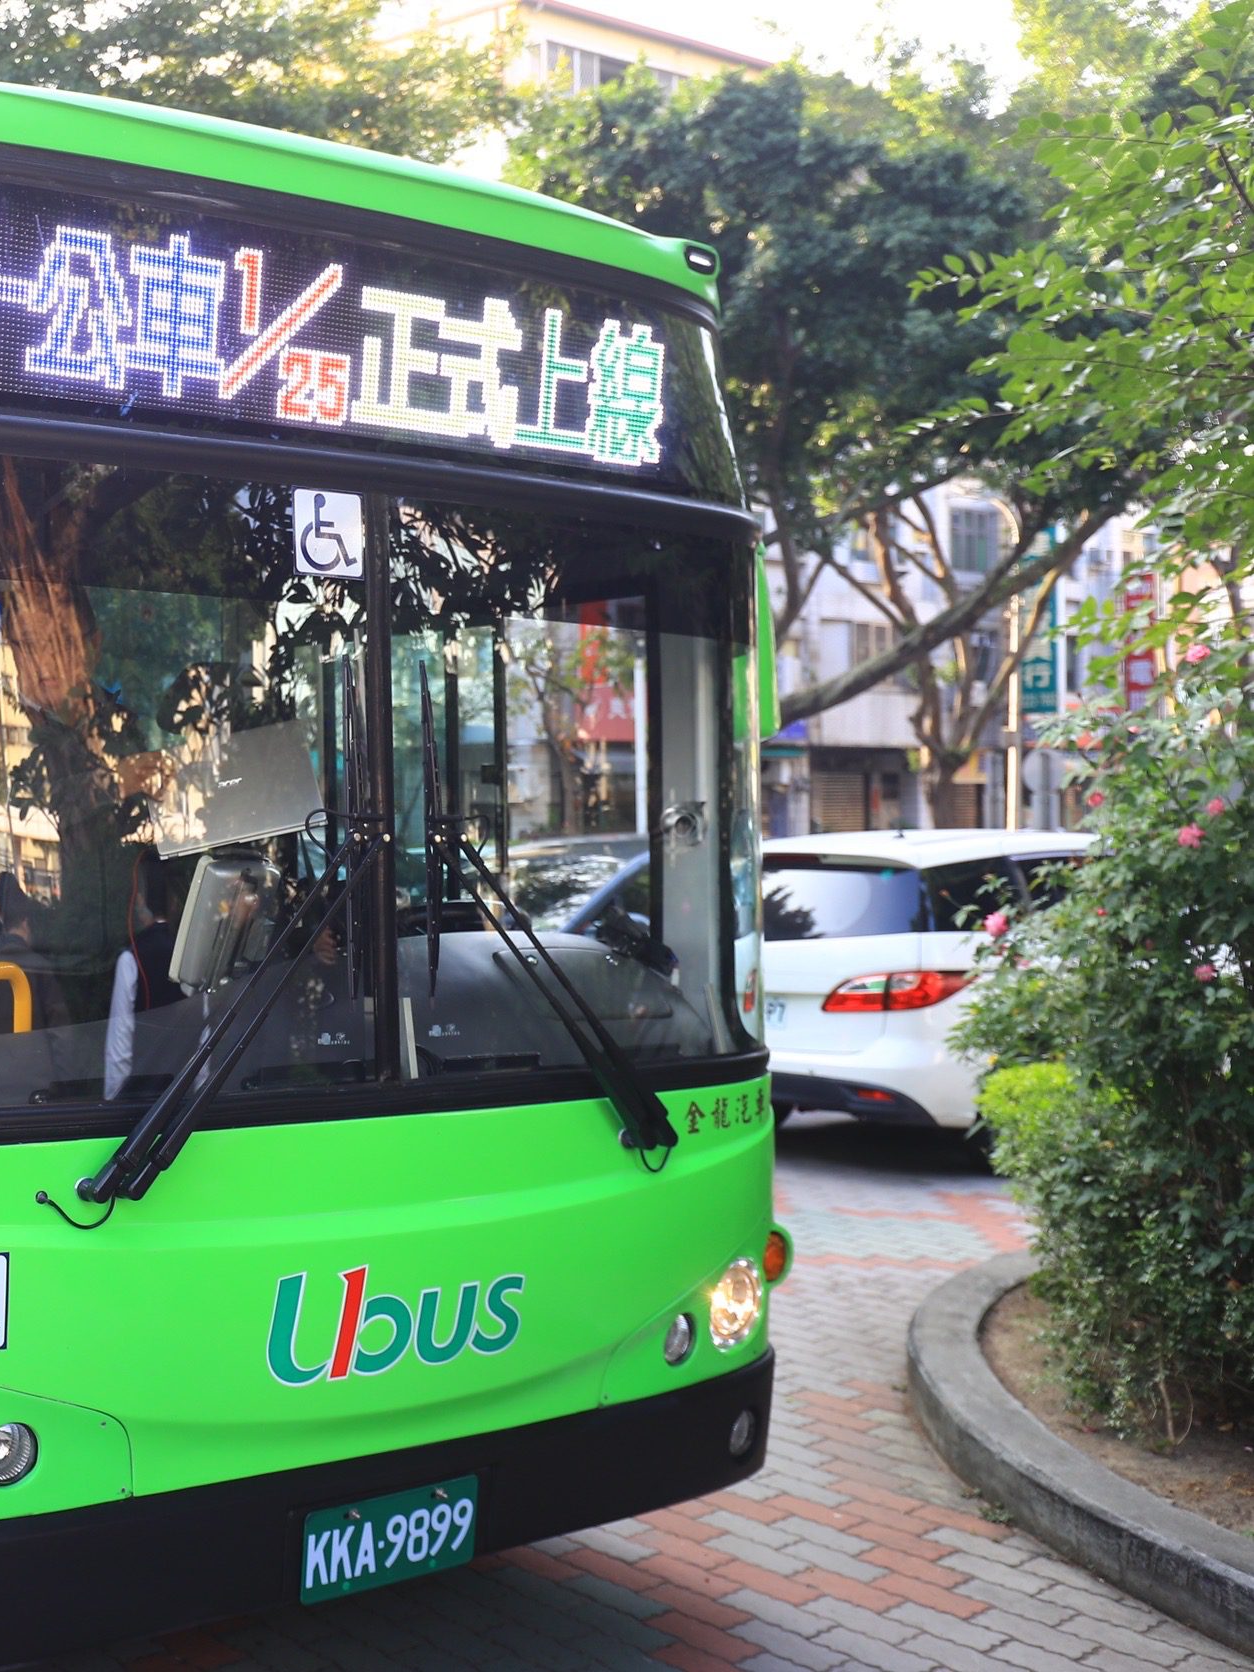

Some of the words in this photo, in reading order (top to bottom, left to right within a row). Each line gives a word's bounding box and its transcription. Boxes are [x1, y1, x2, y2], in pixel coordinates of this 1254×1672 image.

[685, 1087, 765, 1134] 金龍汽車
[266, 1264, 526, 1387] Ubus
